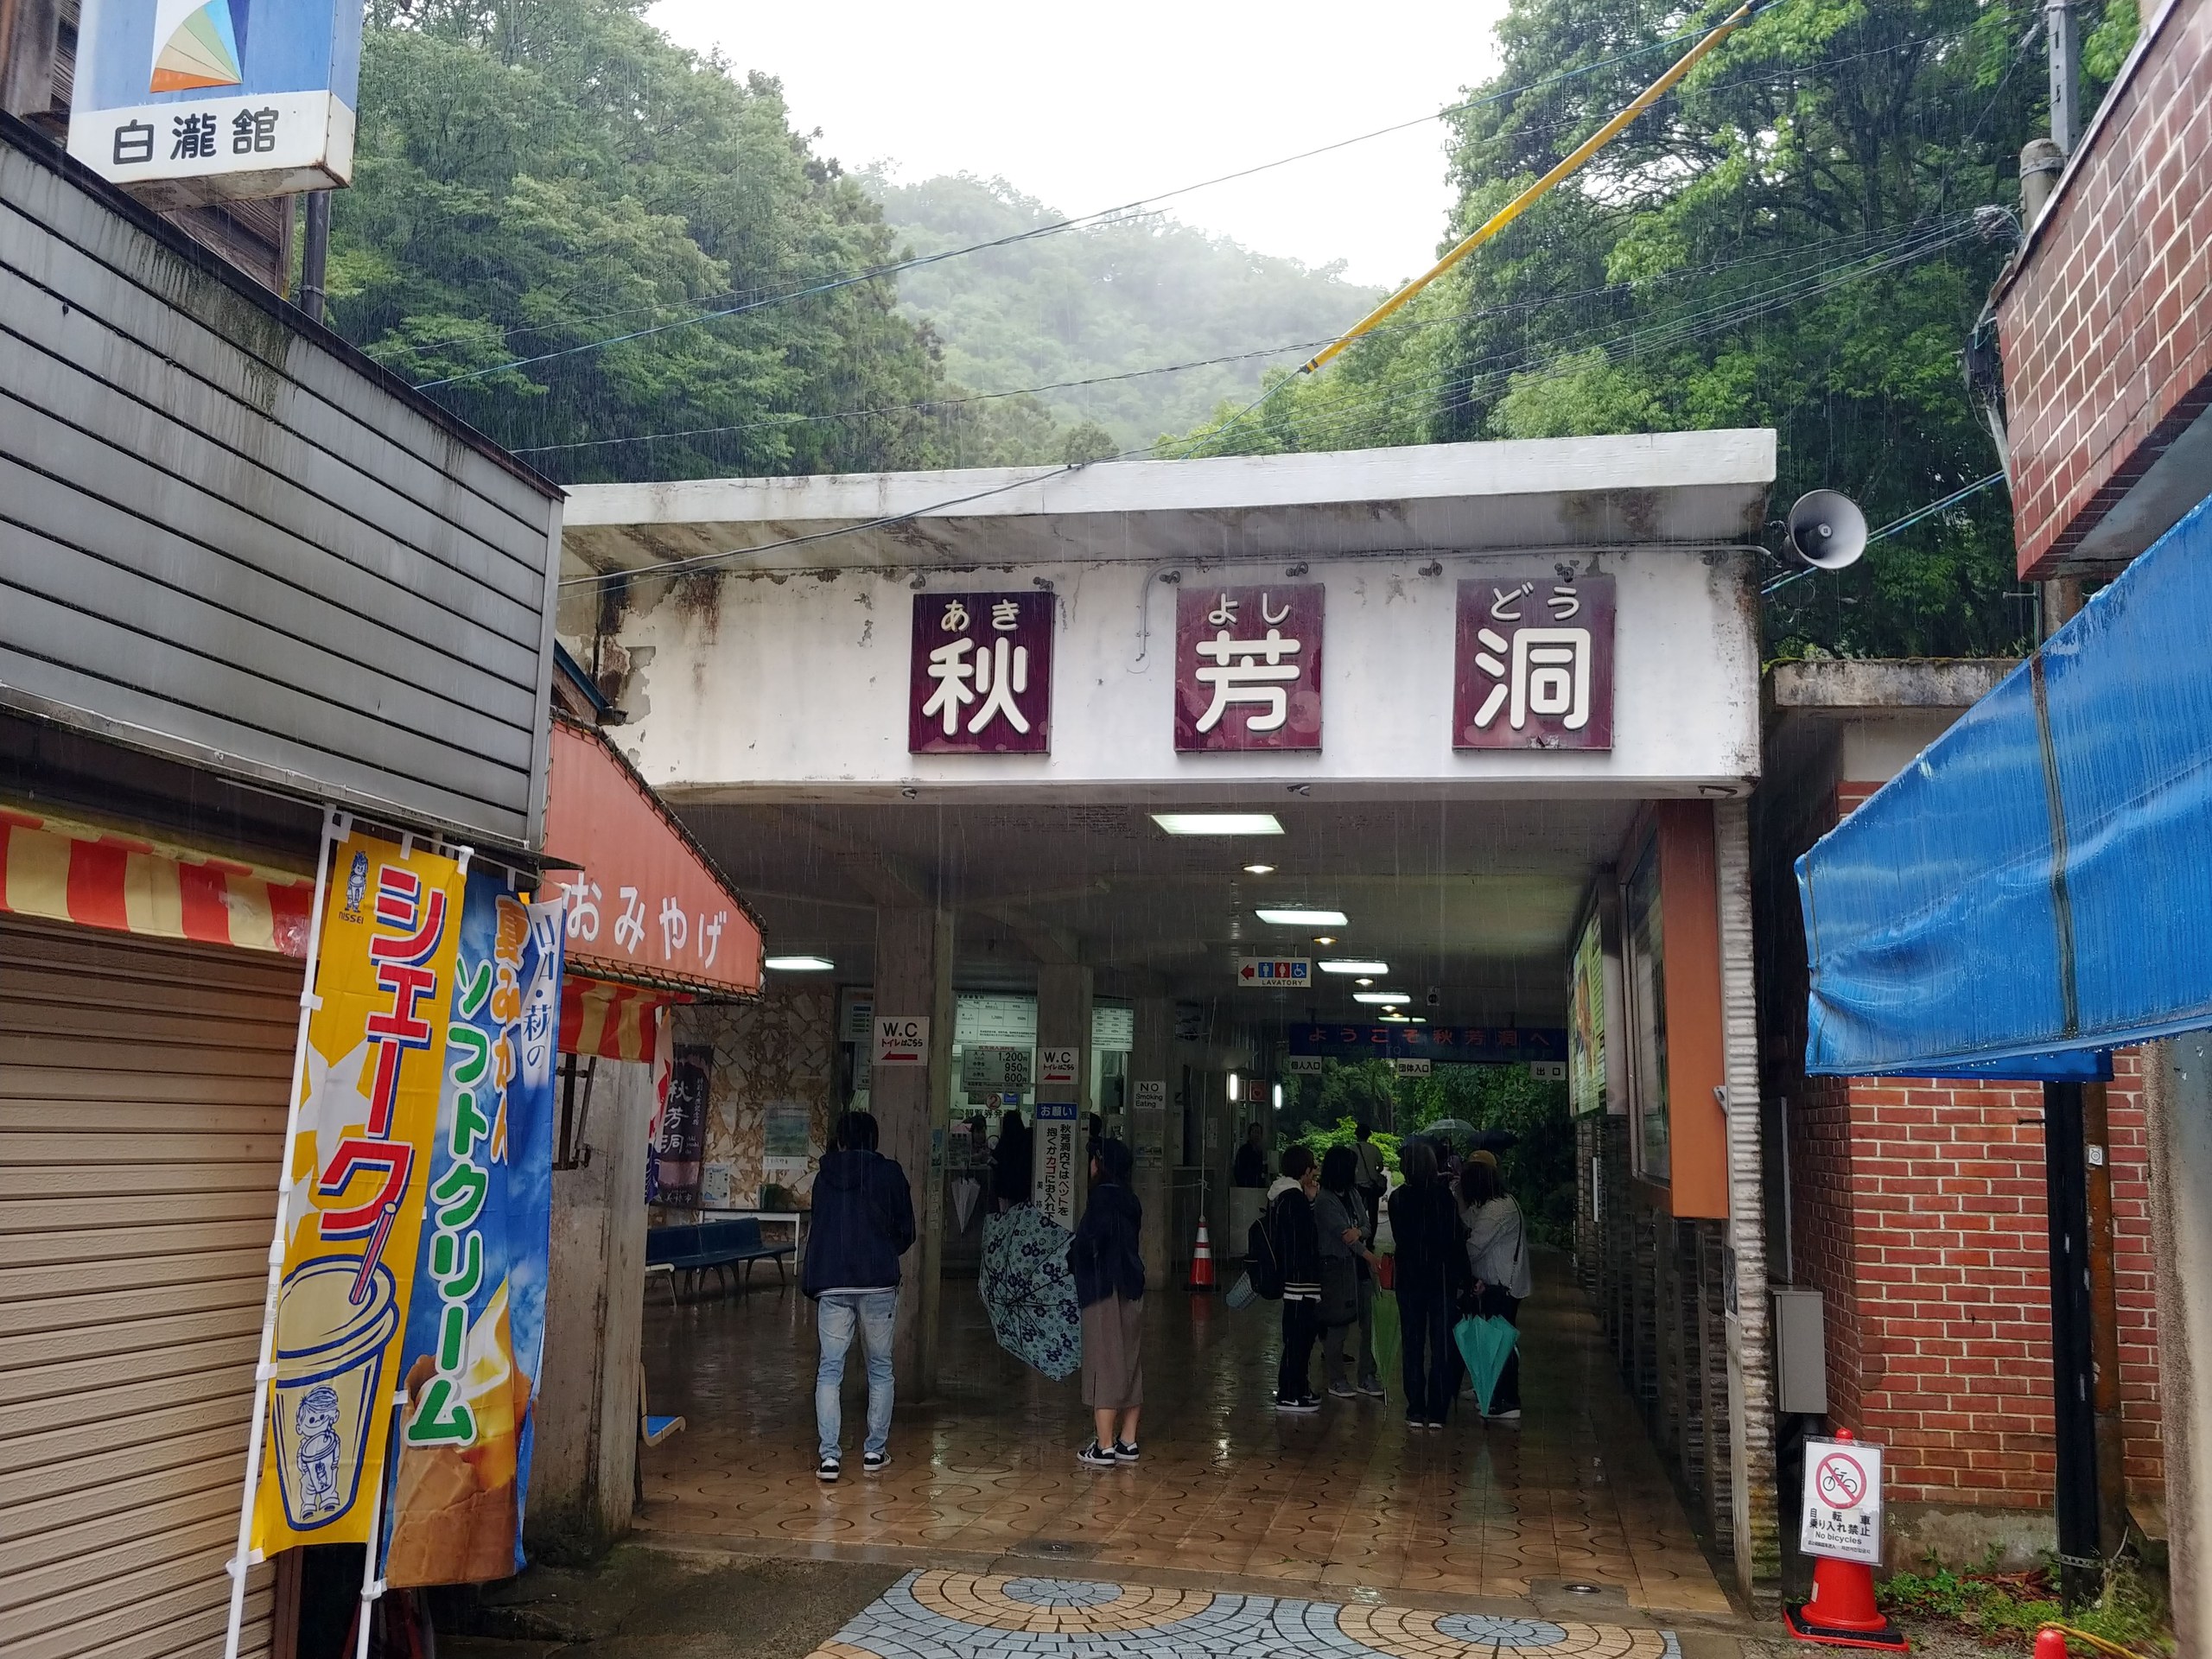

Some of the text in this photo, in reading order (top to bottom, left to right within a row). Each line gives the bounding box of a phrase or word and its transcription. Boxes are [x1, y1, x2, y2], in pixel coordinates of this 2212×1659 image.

[1208, 591, 1291, 626] よし
[1491, 582, 1580, 621] どう
[940, 600, 1020, 632] あき
[923, 636, 1031, 736] 秋
[1195, 629, 1302, 734] 芳
[1473, 626, 1592, 732] 洞
[339, 911, 365, 925] NISSEI
[566, 872, 728, 969] おみやげ
[883, 1022, 918, 1038] W.C
[881, 1039, 923, 1048] トイレはこちら
[1044, 1052, 1071, 1064] W.C
[1398, 1064, 1429, 1073] 団体入口
[1536, 1066, 1560, 1076] 出口
[1140, 1083, 1160, 1092] NO
[1135, 1093, 1163, 1102] Smoking
[1135, 1100, 1156, 1109] Eating
[662, 1078, 693, 1154] 秋芳洞
[1040, 1105, 1073, 1117] お願い
[405, 952, 493, 1446] ソフトクリーム
[1809, 1507, 1872, 1526] 自転車
[1809, 1517, 1872, 1537] 乗り入れ禁止
[1815, 1530, 1826, 1539] No
[1827, 1532, 1863, 1545] bicycles
